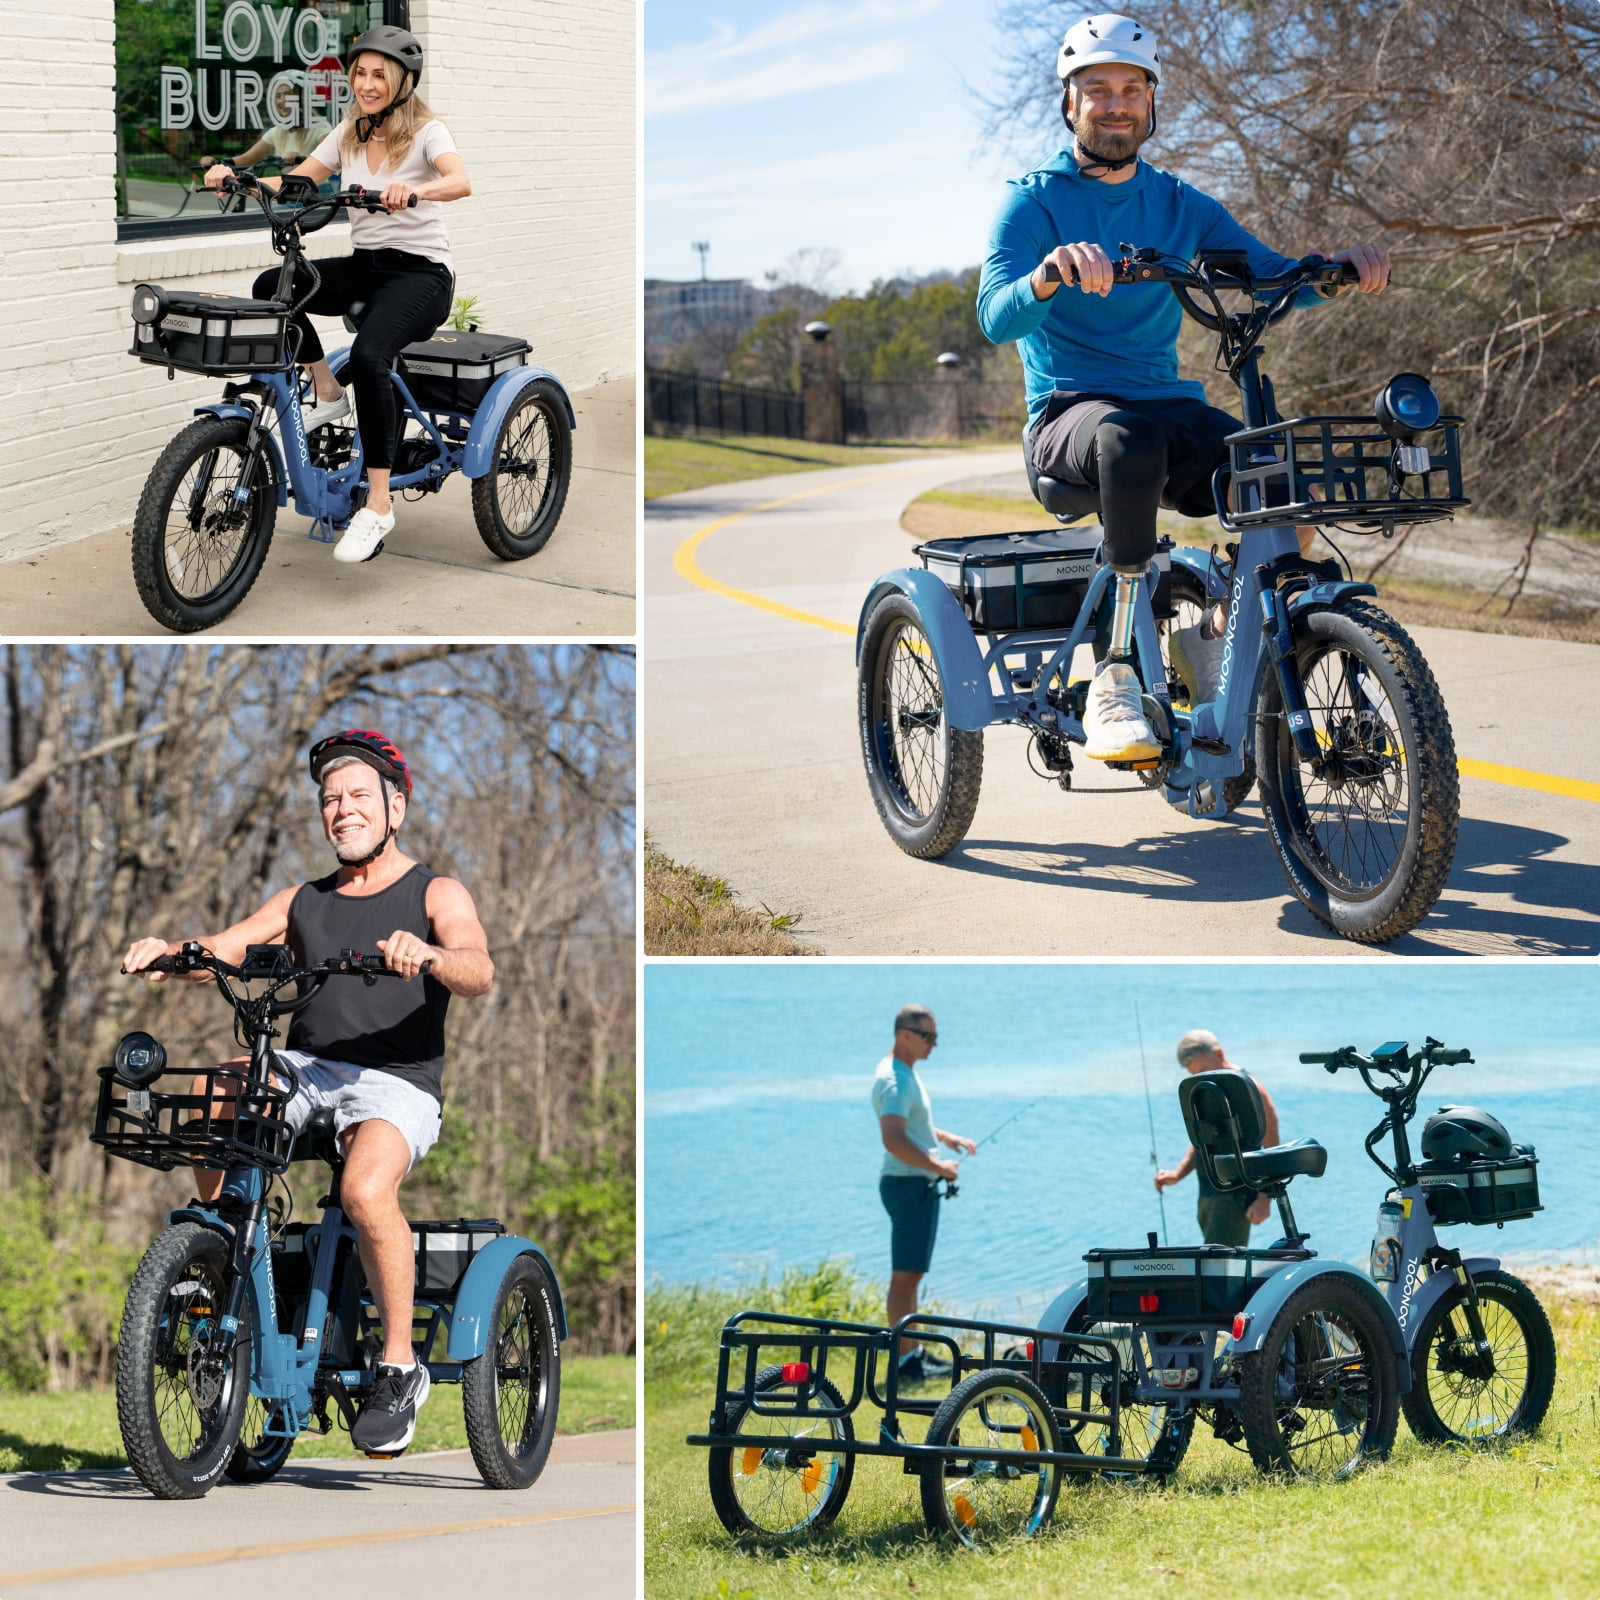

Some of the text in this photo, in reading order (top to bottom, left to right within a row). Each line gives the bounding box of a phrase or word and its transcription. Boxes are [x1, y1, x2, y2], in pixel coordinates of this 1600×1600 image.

[195, 0, 329, 66] LOYO
[160, 65, 355, 132] BURGER
[1217, 575, 1245, 696] MOONCOOL
[862, 718, 870, 756] PATROL
[1280, 846, 1300, 884] PATROL
[262, 1215, 277, 1325] MOONCOOL
[1398, 1256, 1418, 1332] OONCOOL
